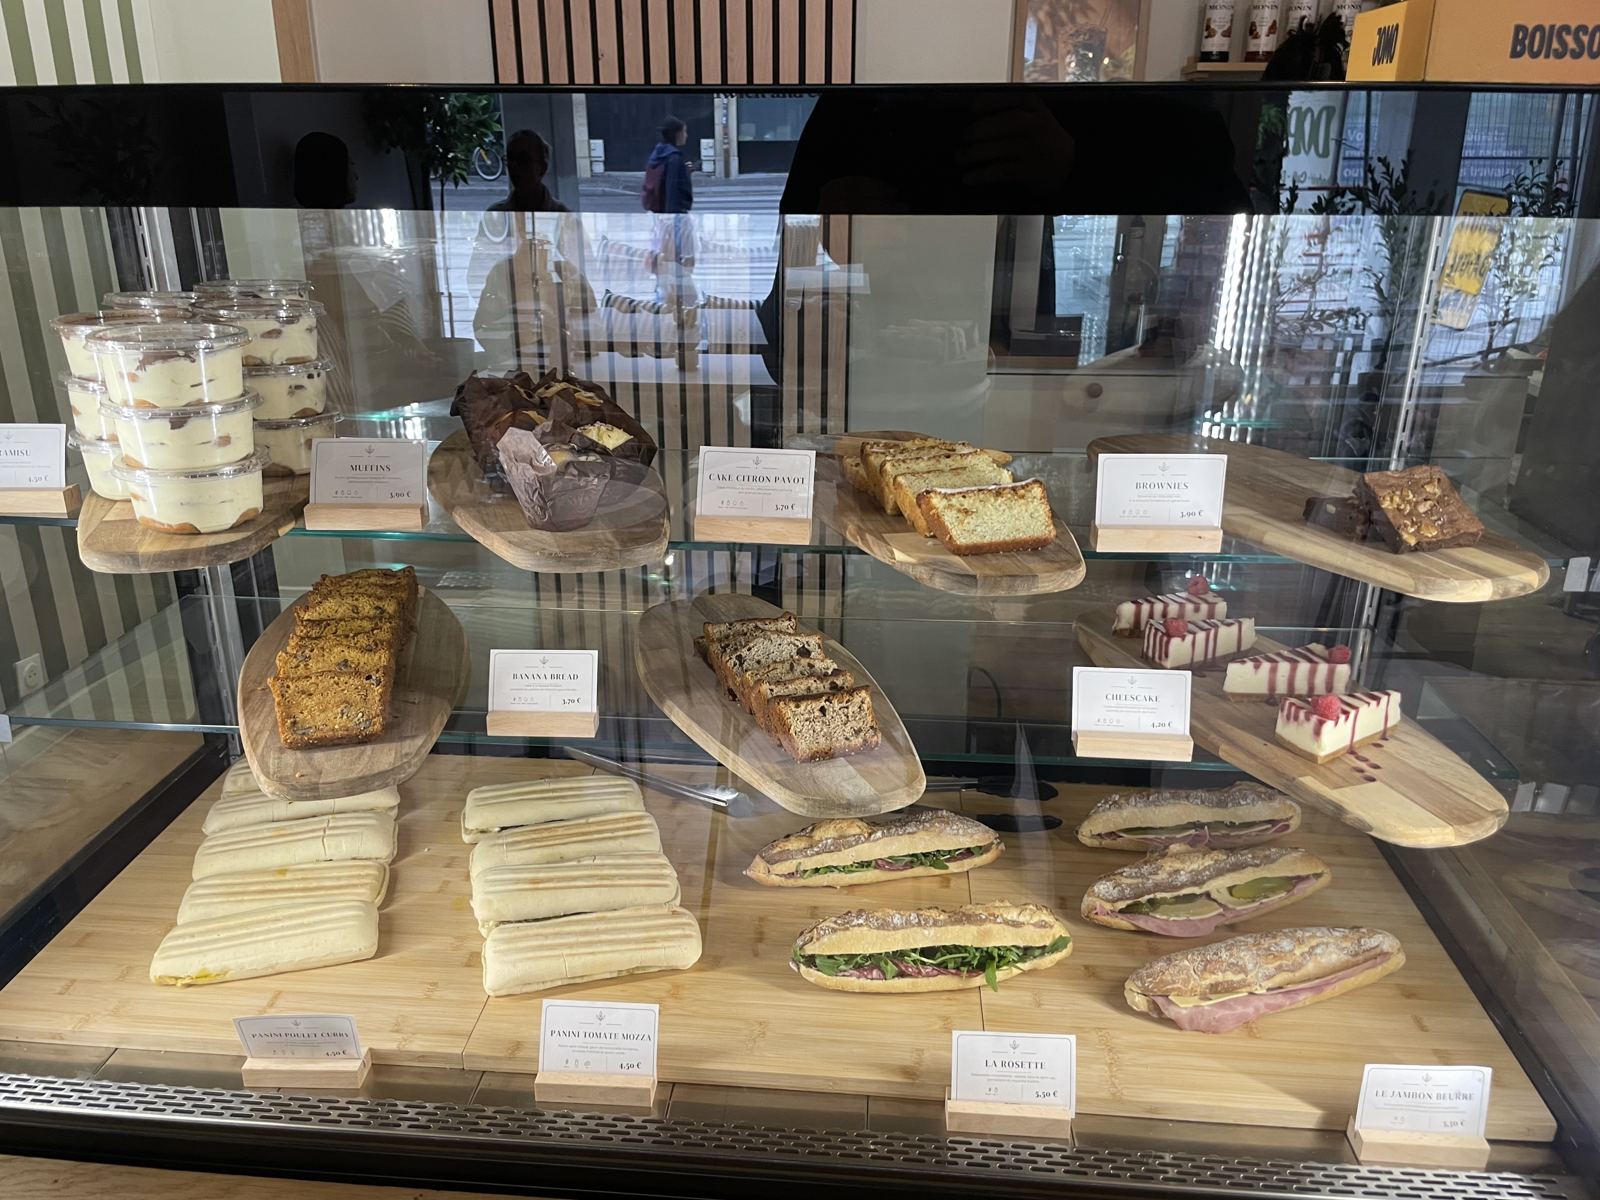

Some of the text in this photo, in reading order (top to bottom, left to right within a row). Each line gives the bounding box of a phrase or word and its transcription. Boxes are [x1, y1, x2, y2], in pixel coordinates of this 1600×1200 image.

[1371, 23, 1399, 67] JOMO
[1509, 23, 1600, 60] BOISSO
[350, 464, 391, 472] MUFFINS
[708, 473, 805, 485] CAKE CITRON PAVOT
[1135, 481, 1189, 490] BROWNIES
[550, 673, 579, 681] BREAD
[550, 1029, 652, 1042] PANINI TOMATE MOZZA
[985, 1059, 1046, 1070] LA ROSETTE
[1375, 1089, 1474, 1101] LE JAMBON BEURRE
